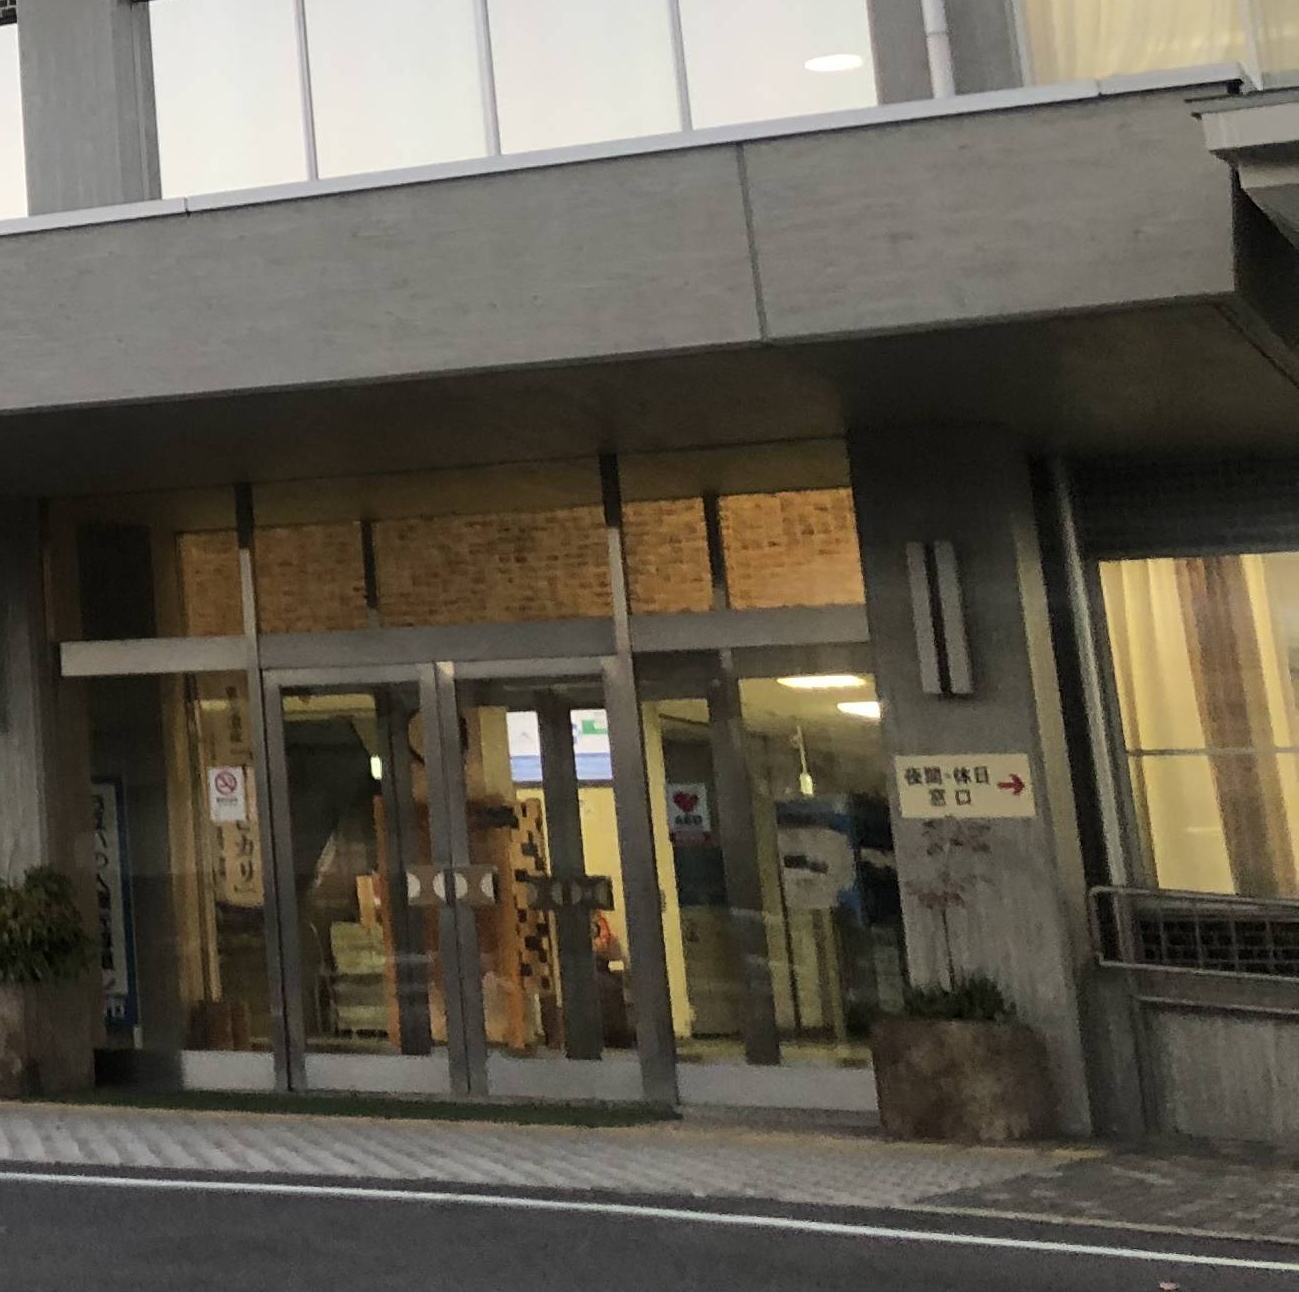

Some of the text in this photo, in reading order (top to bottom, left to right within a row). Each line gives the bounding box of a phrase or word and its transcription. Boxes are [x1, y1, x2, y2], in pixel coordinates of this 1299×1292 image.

[904, 765, 991, 786] 夜間・休日
[928, 788, 972, 807] 窓口
